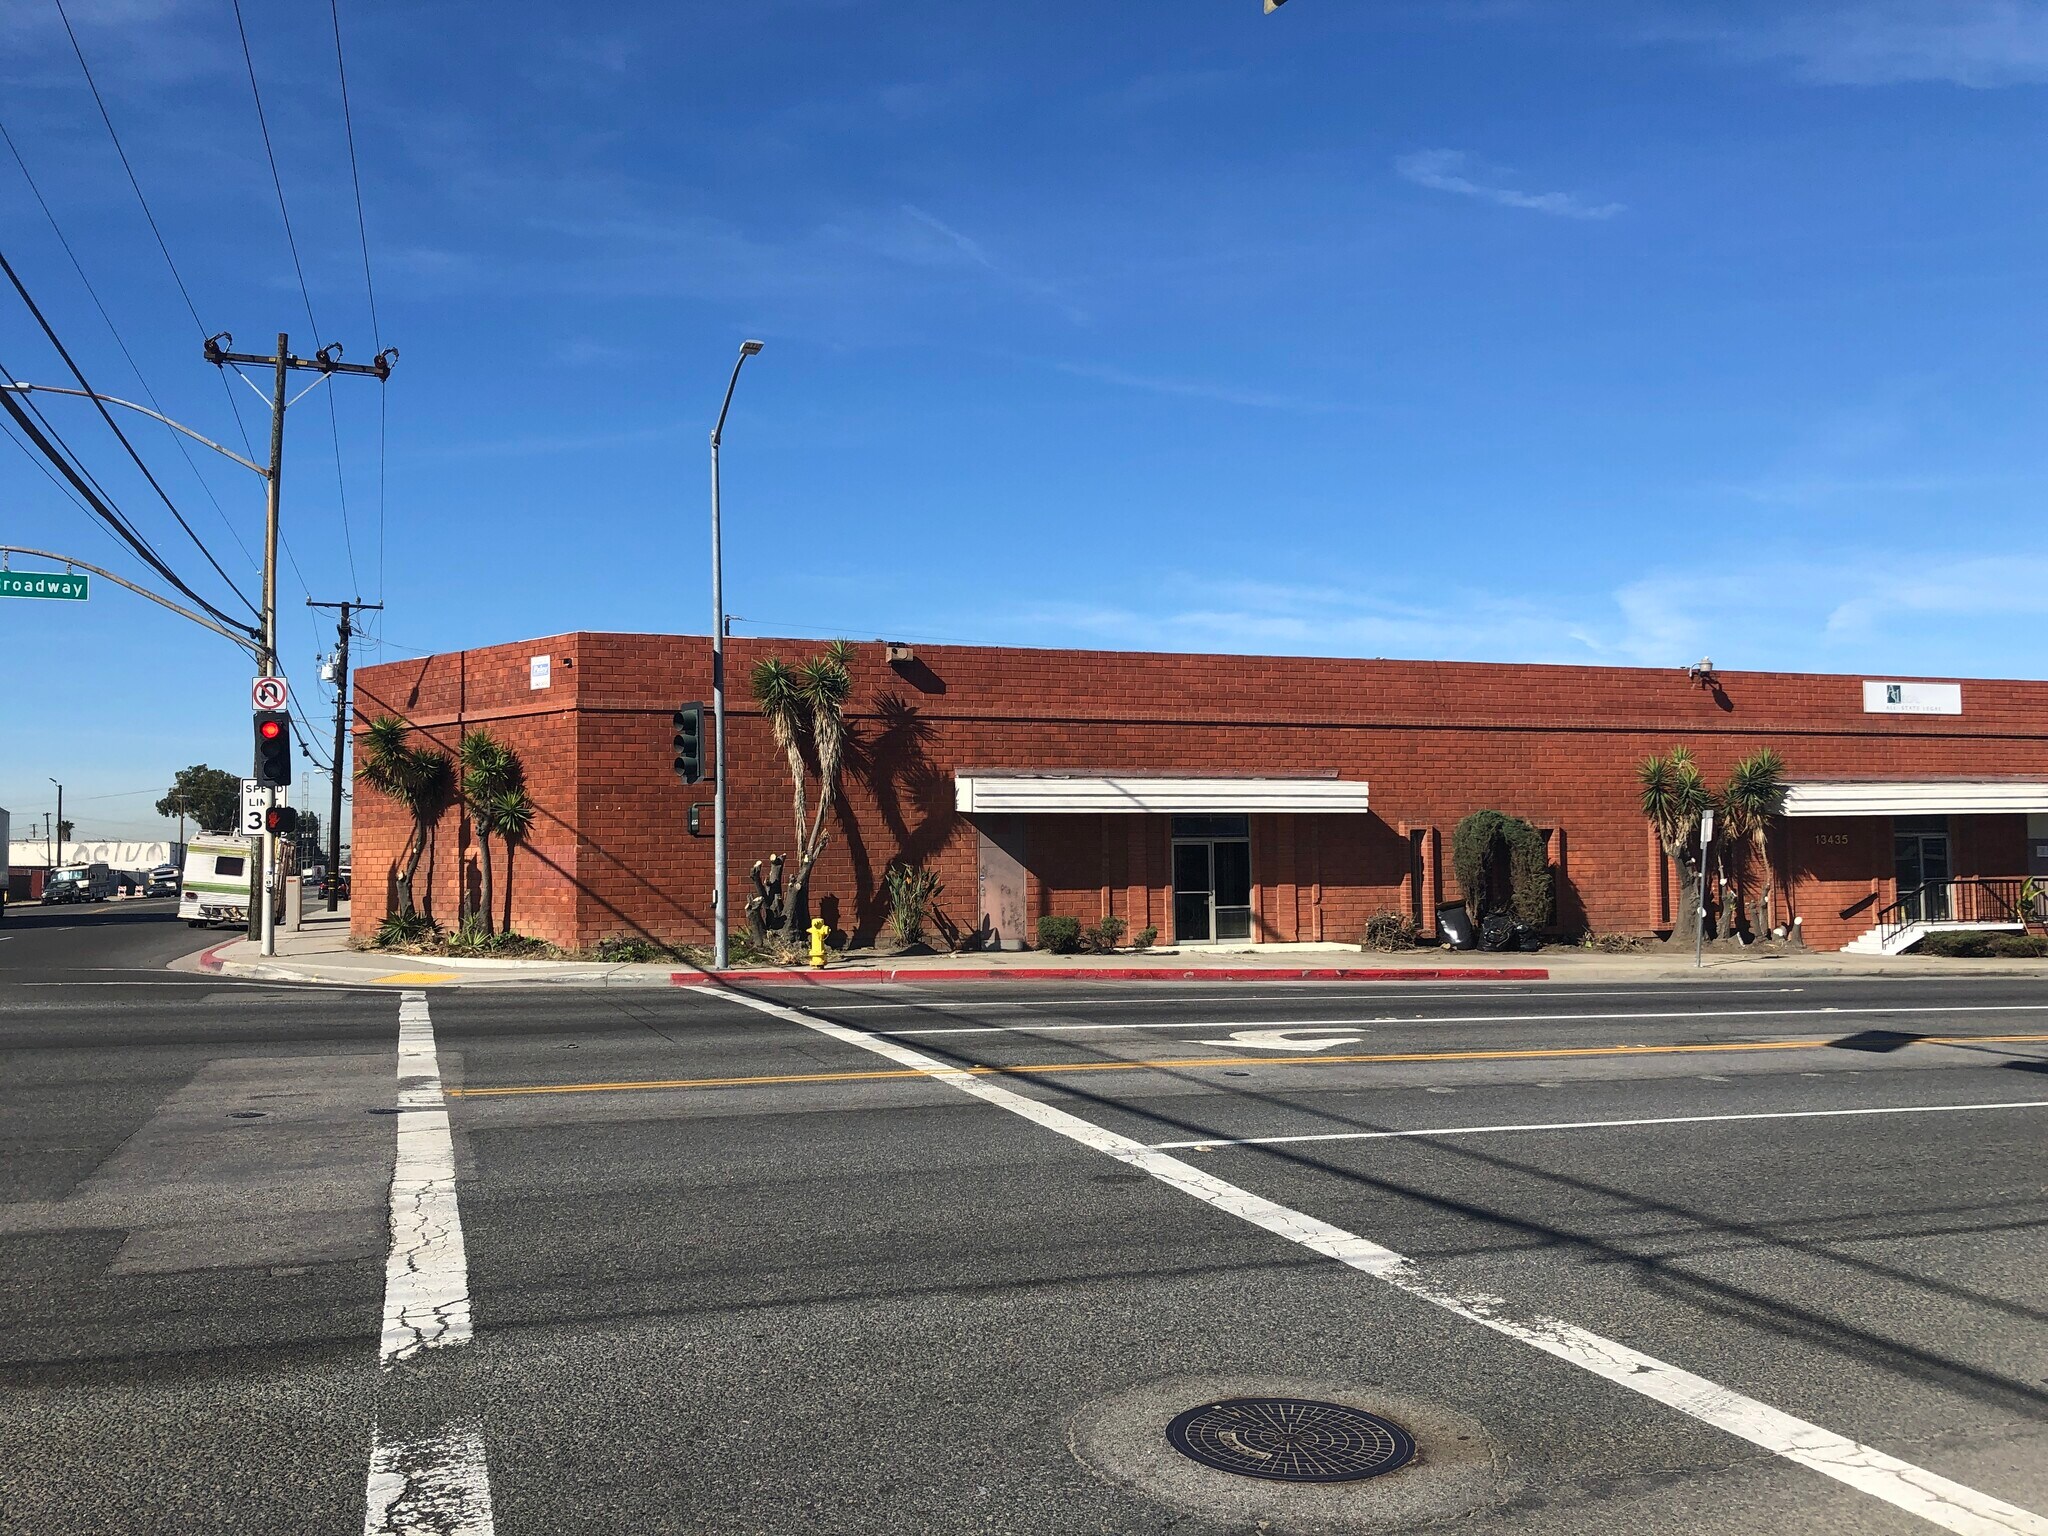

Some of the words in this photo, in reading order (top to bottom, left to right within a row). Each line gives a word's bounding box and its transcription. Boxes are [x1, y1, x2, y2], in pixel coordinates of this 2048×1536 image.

[0, 579, 83, 597] roadway
[245, 785, 284, 793] SPED
[247, 811, 263, 830] 3
[1815, 834, 1848, 844] 13435
